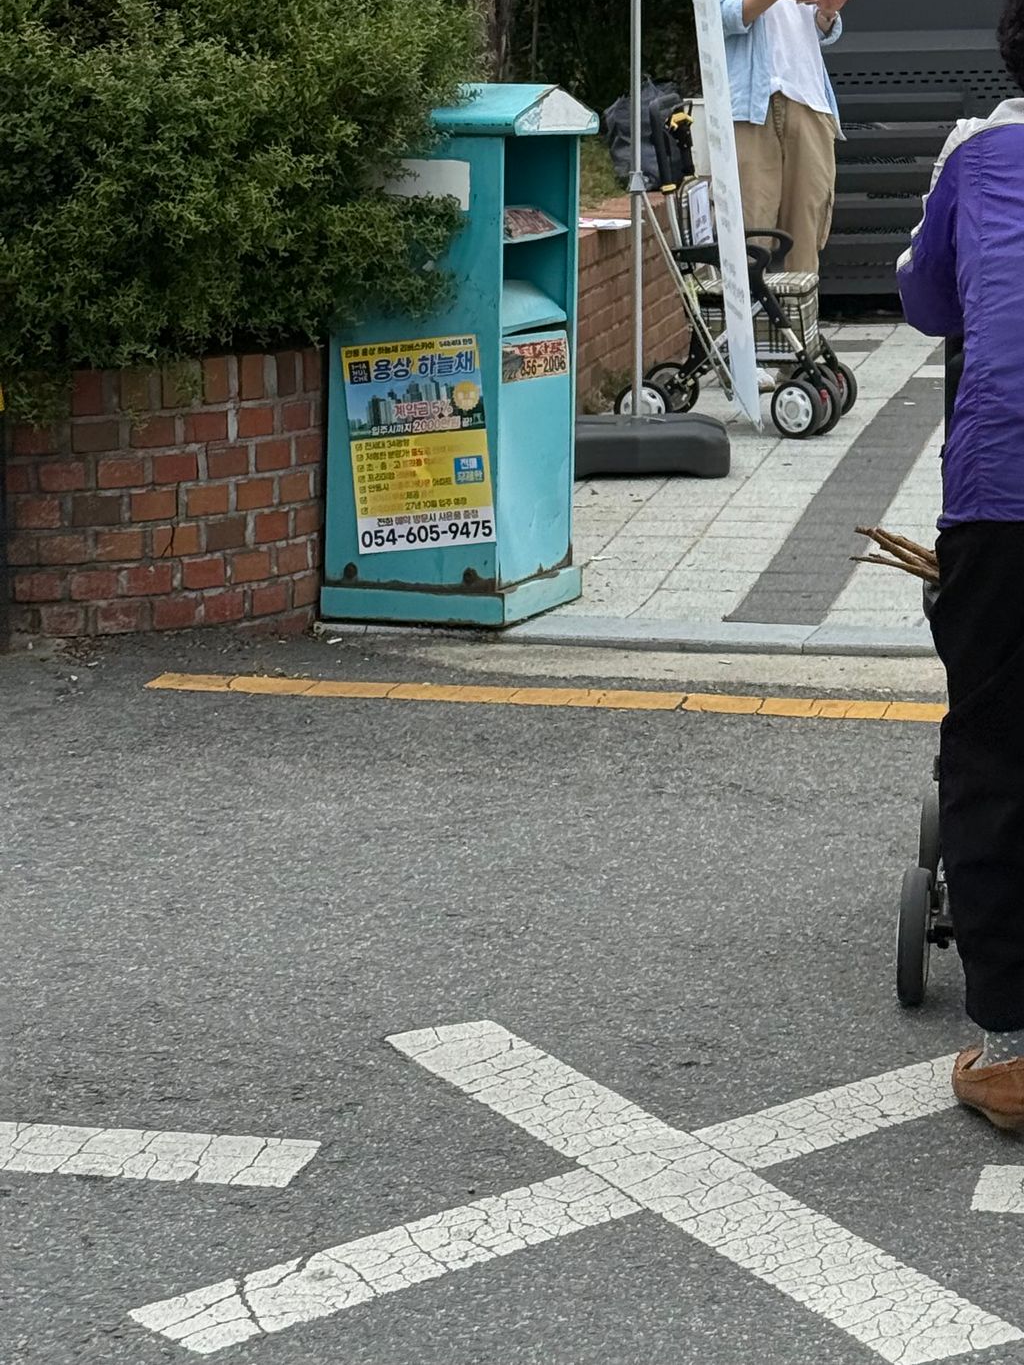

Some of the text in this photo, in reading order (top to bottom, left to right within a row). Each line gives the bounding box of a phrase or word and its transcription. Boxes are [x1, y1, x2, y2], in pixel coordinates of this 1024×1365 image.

[373, 351, 475, 381] 용상 하늘채
[394, 401, 429, 418] 계약금
[371, 422, 412, 436] 입주시까지
[361, 519, 493, 549] 054-605-9475
